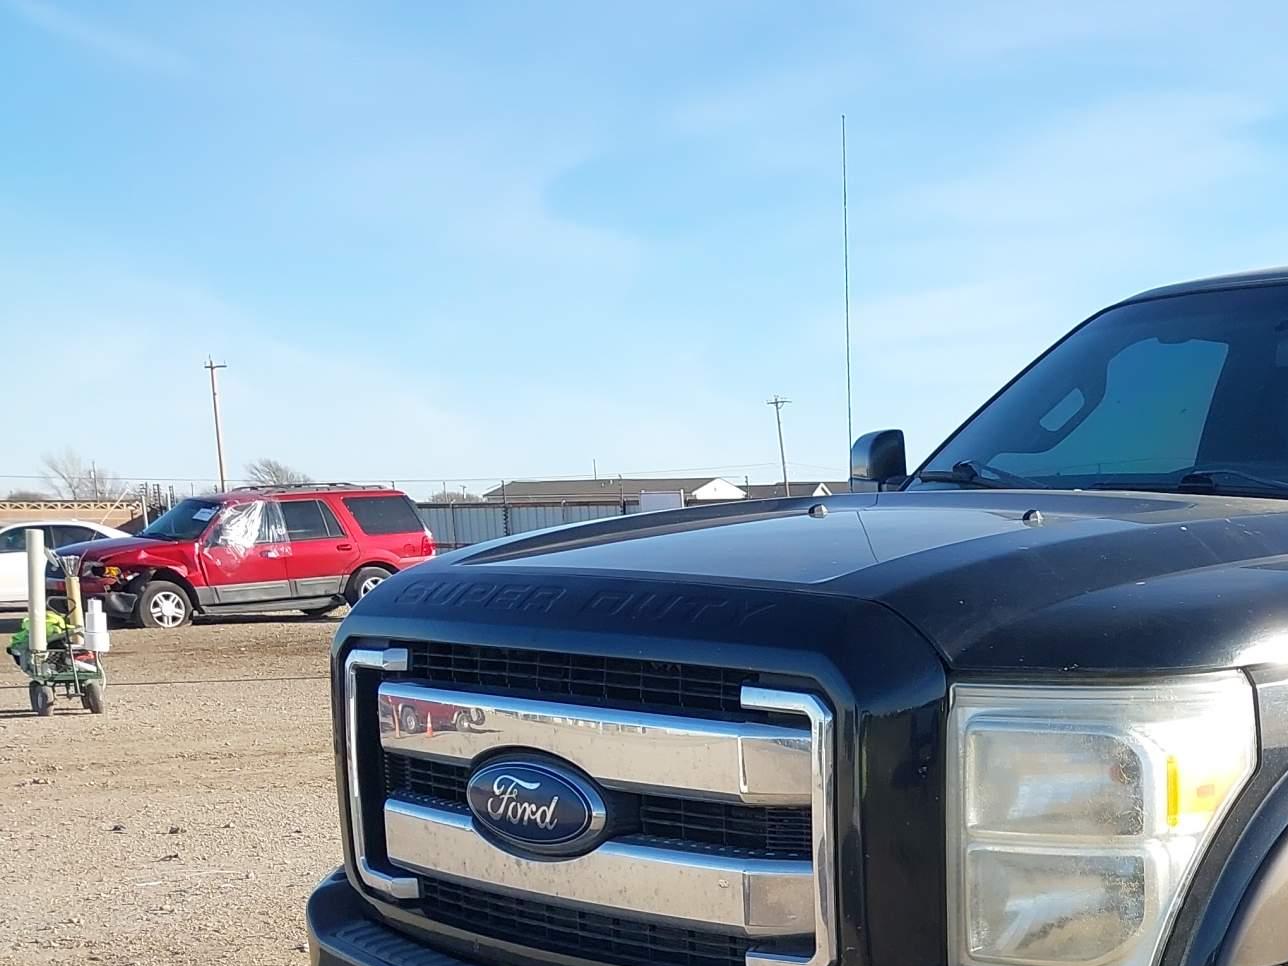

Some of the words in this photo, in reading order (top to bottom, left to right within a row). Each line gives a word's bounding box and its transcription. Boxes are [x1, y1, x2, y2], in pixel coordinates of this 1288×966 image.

[395, 580, 568, 615] SUPER
[578, 589, 777, 627] DUTY
[487, 774, 560, 831] Ford
